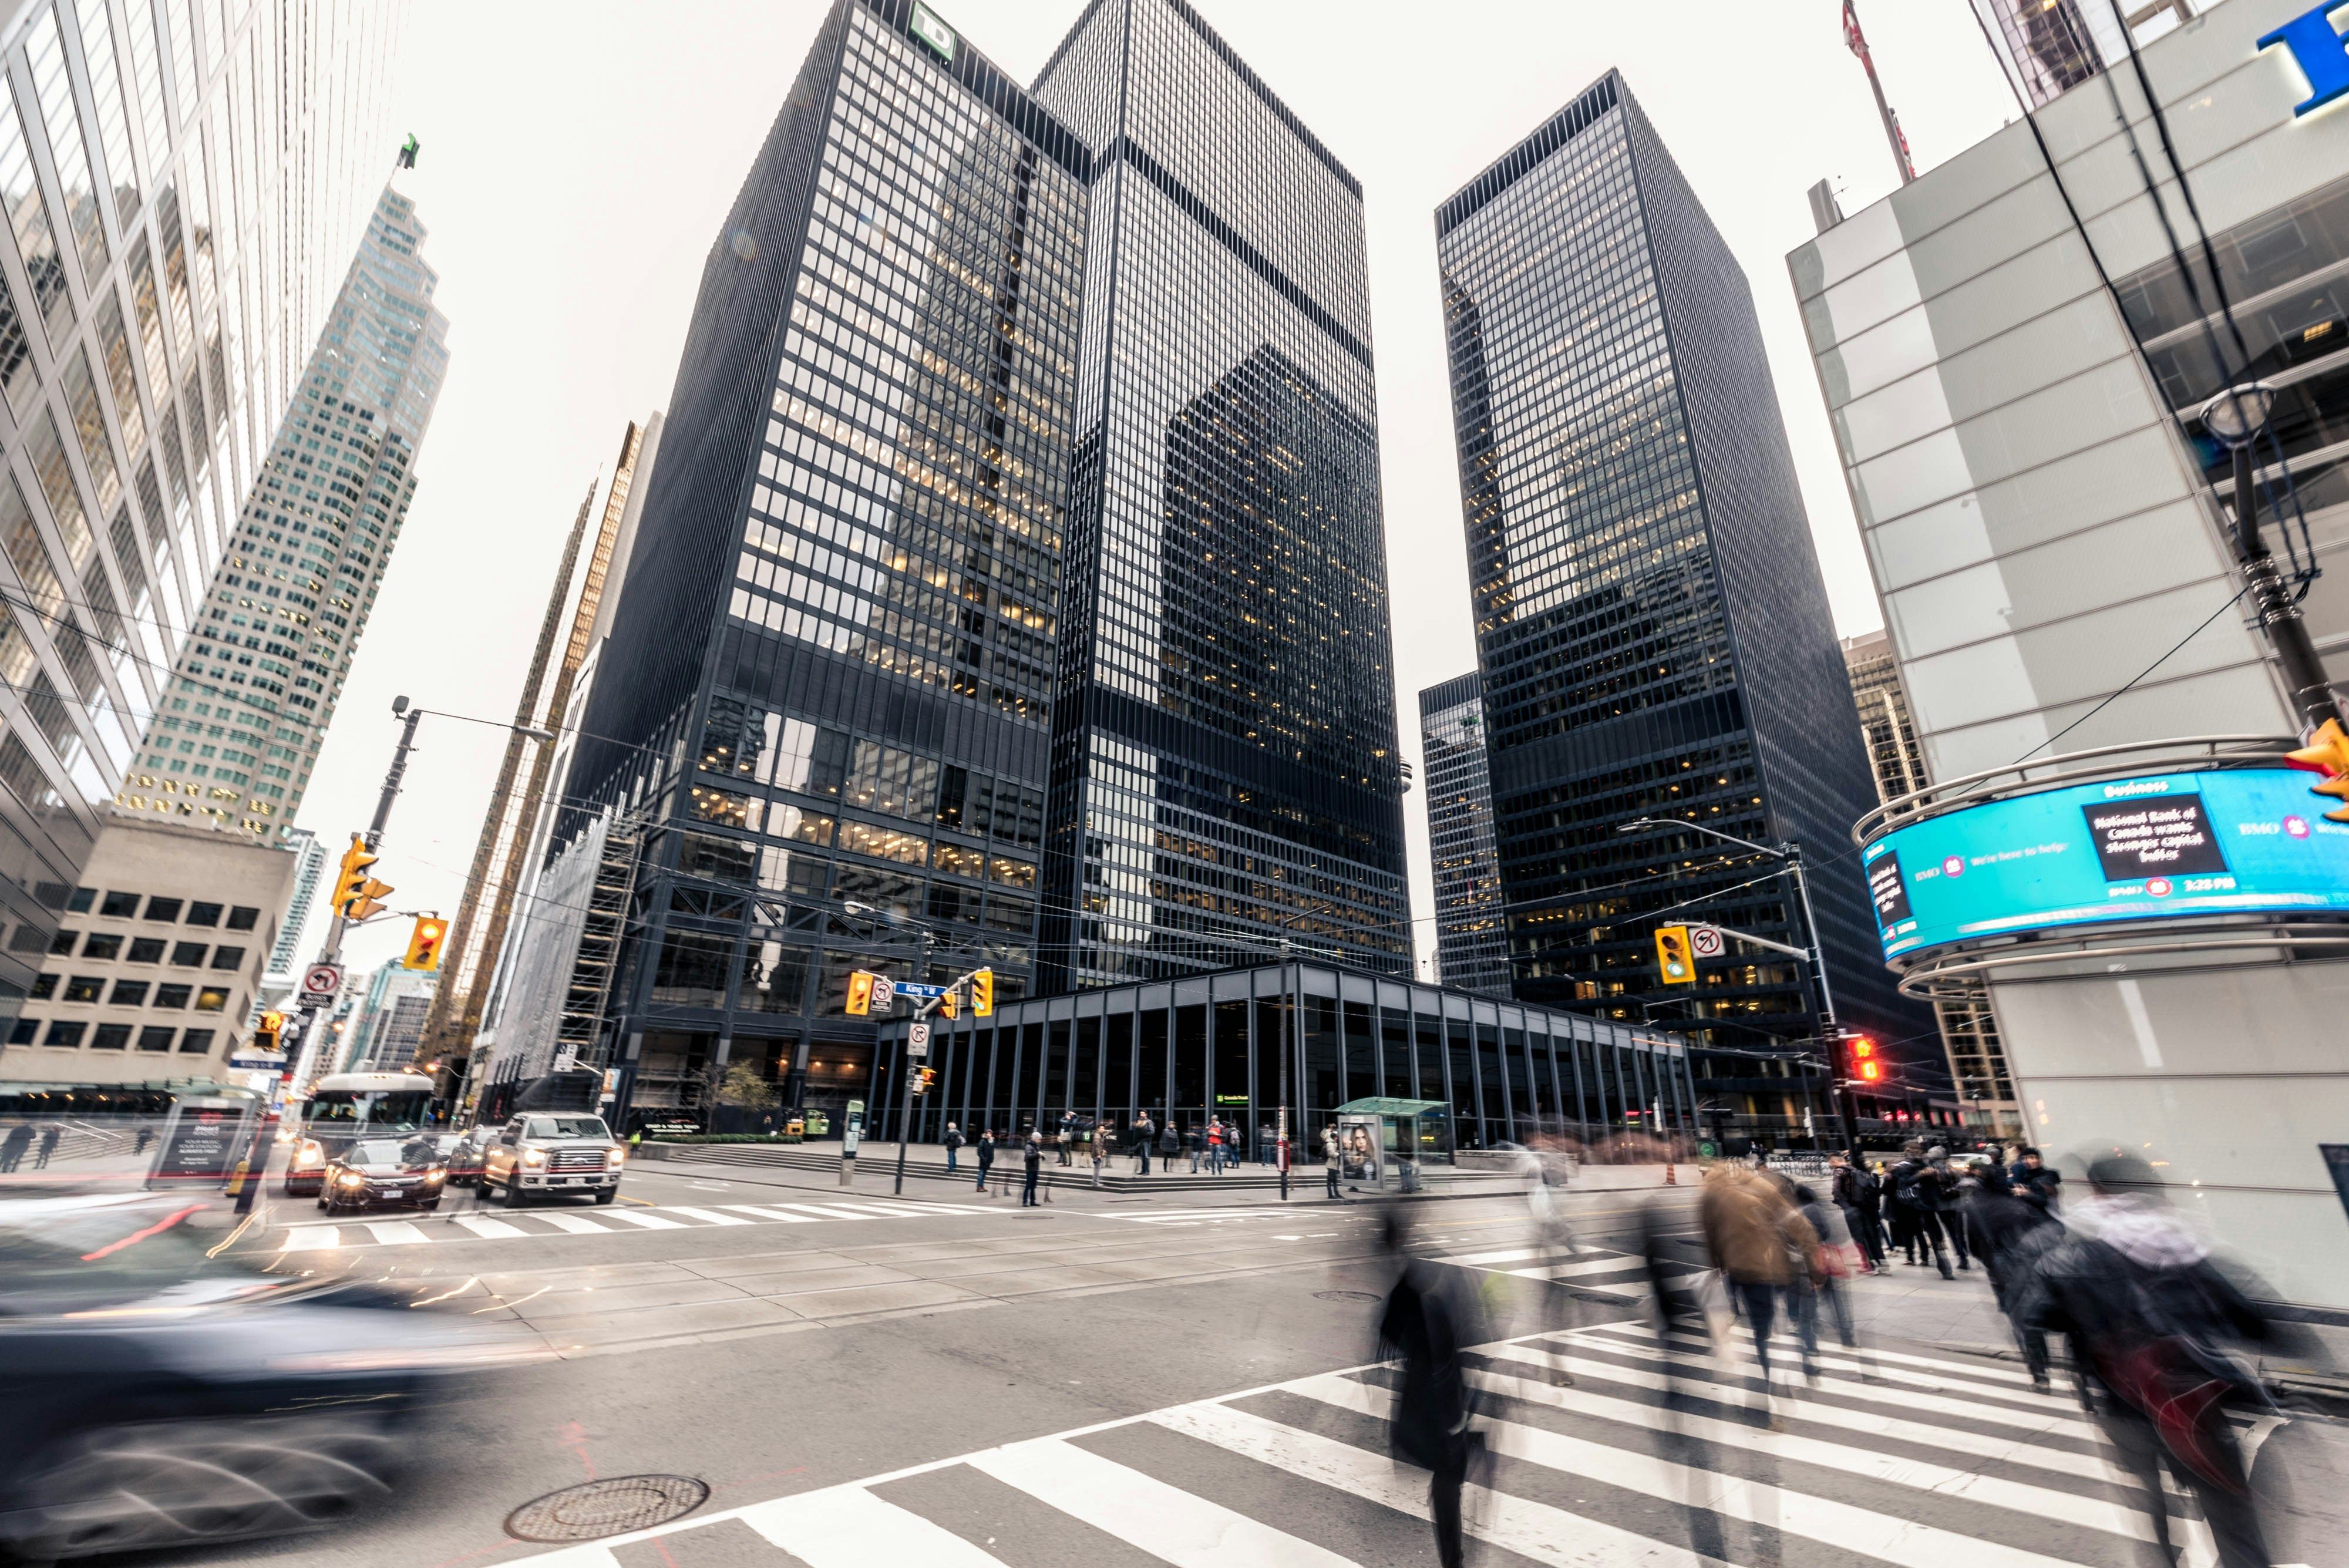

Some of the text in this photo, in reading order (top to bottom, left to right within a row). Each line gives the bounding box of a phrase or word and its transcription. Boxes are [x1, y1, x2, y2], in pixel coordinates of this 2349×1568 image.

[918, 9, 950, 49] TD
[2104, 782, 2169, 798] Business
[2094, 807, 2196, 829] National Bank of
[2107, 822, 2194, 840] Canada wants
[2239, 823, 2280, 835] BMO
[1915, 867, 1940, 881] BMO
[1970, 854, 1997, 866] We're
[1998, 850, 2022, 861] here
[2024, 847, 2037, 857] to
[2213, 877, 2236, 889] PM
[906, 984, 923, 995] King
[240, 1061, 259, 1069] King
